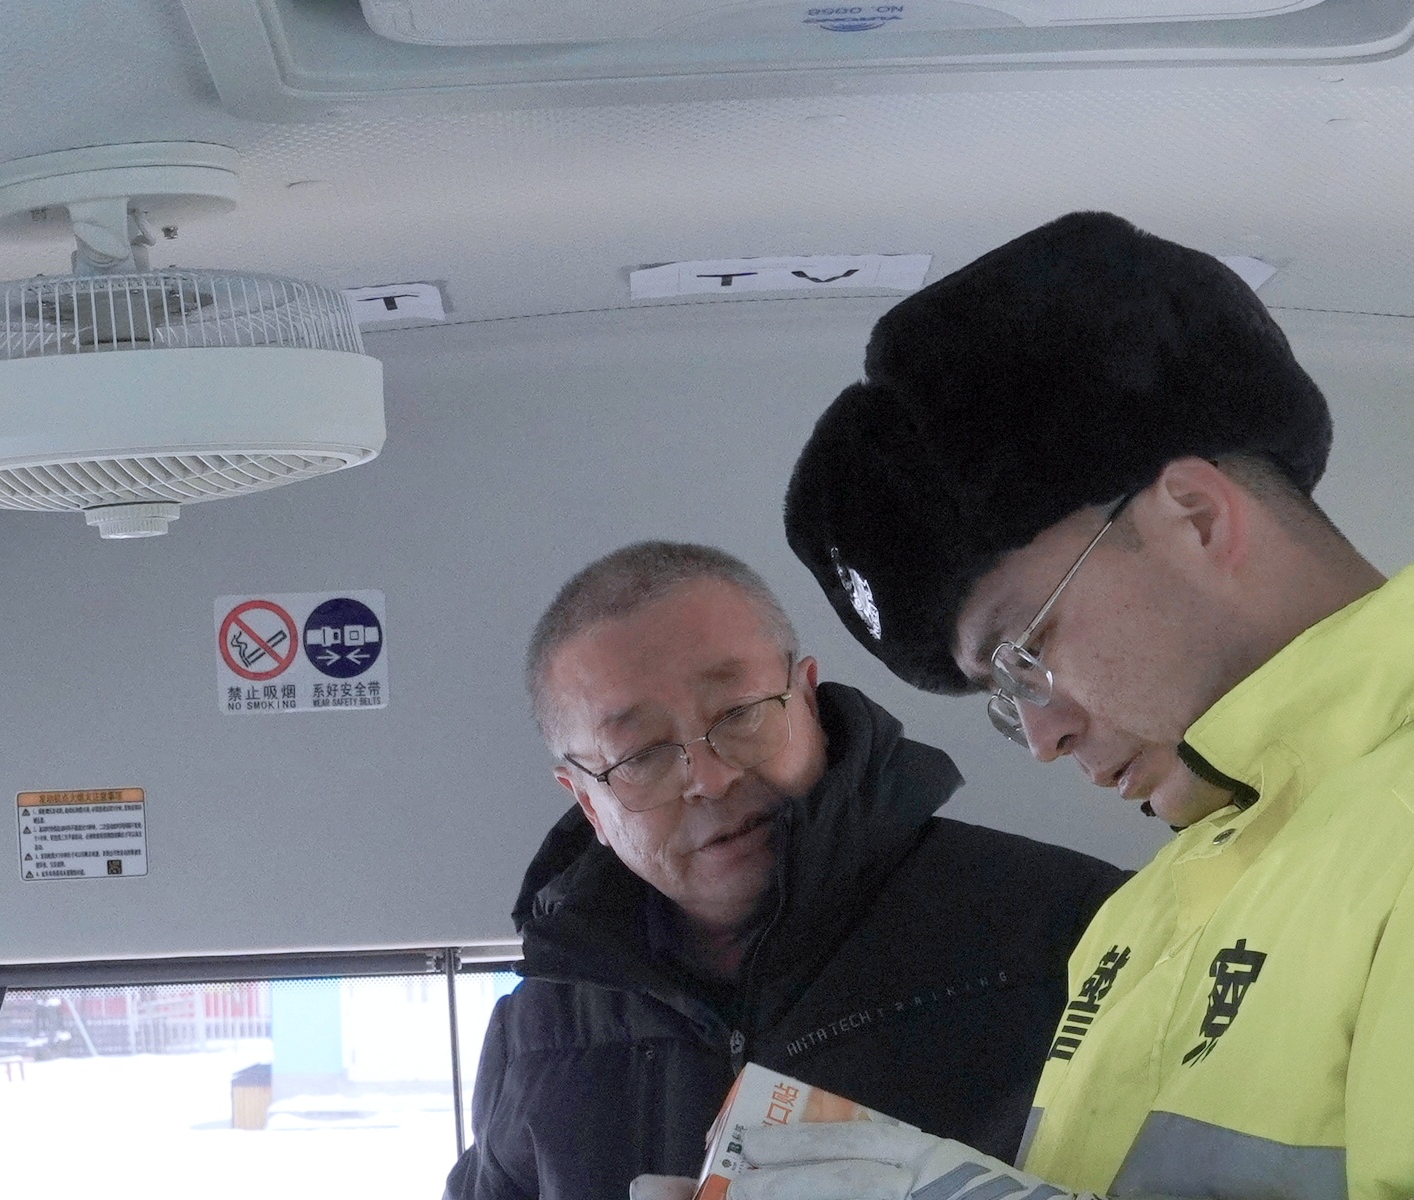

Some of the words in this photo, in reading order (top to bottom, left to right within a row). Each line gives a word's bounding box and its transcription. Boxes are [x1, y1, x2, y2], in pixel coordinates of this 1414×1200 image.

[228, 684, 296, 701] 禁止吸烟
[312, 681, 381, 698] 系好安全带
[228, 702, 242, 710] NO
[247, 700, 296, 710] SMOKING
[332, 698, 357, 706] SAFETY
[762, 1083, 800, 1127] 口贴
